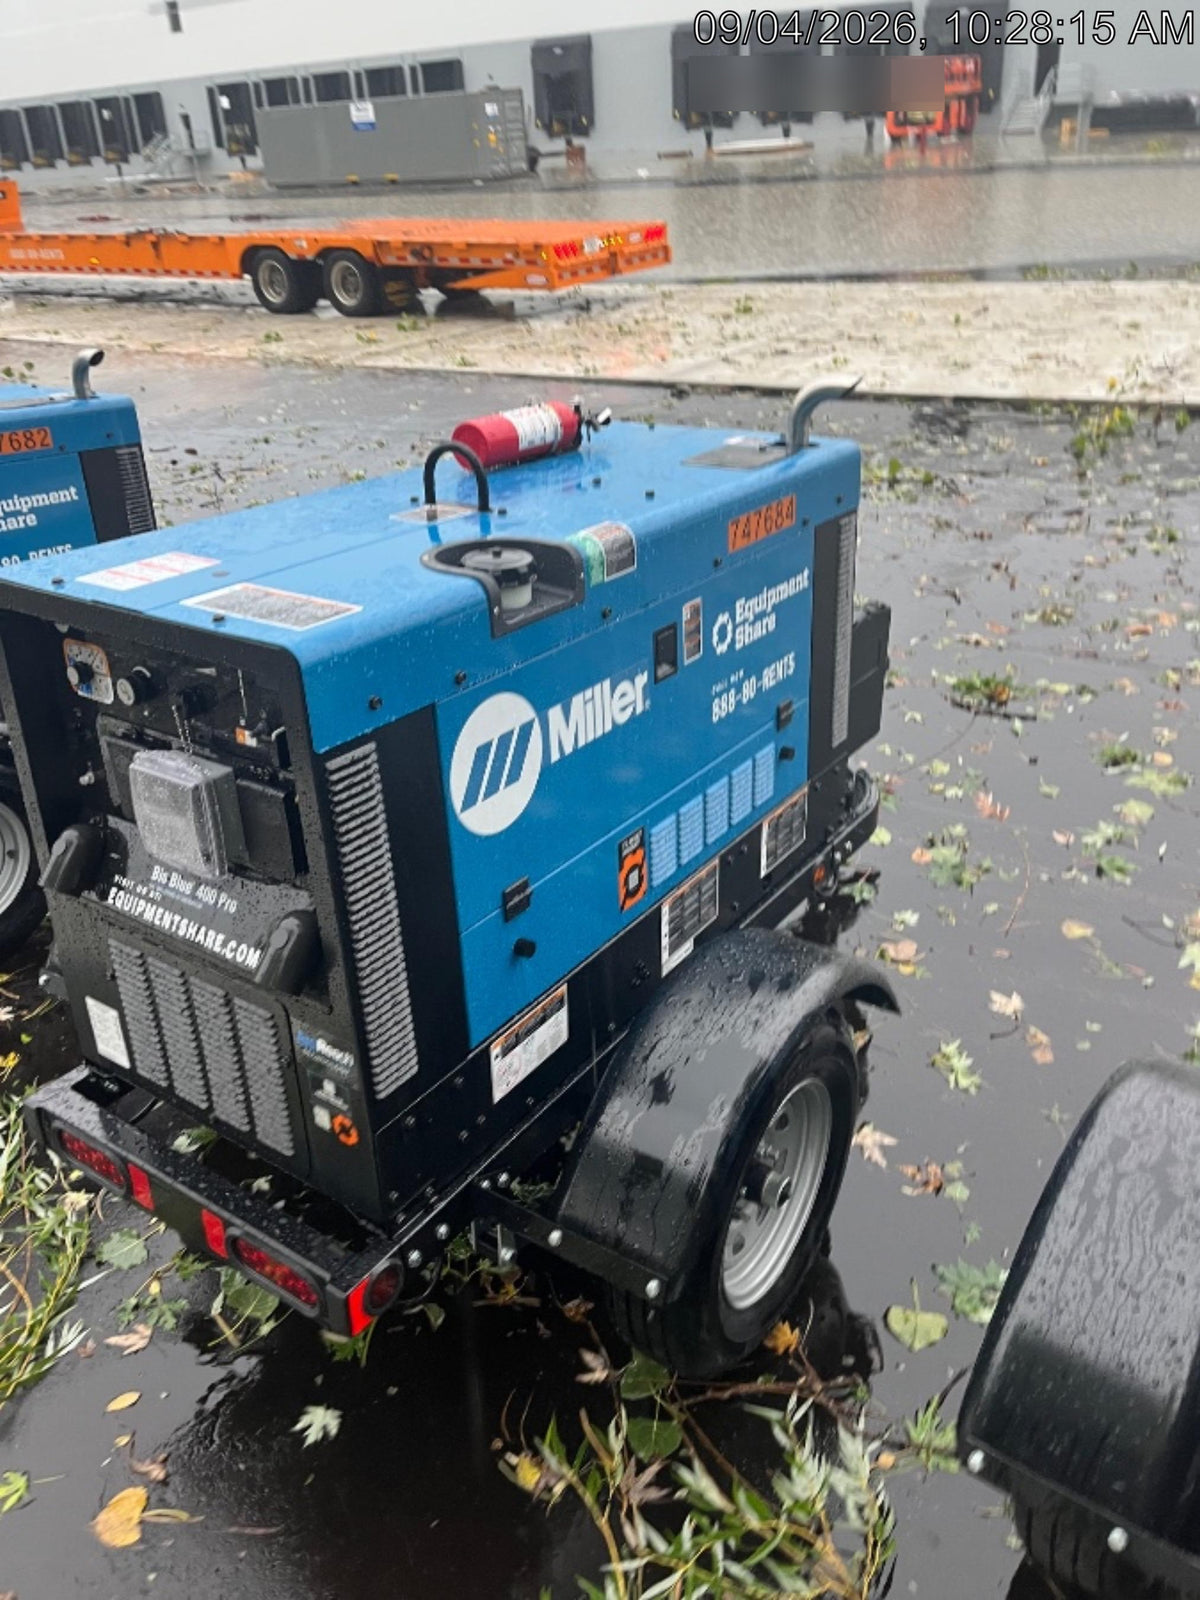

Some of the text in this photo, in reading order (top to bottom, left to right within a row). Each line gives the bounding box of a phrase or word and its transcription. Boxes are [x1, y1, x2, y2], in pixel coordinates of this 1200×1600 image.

[729, 496, 795, 550] 747684
[735, 566, 810, 625] Equipment
[735, 612, 777, 651] Share
[547, 669, 649, 765] Miller
[712, 651, 796, 724] 888-80-RENTS
[107, 886, 262, 970] EQUIPMENTSHARE.COM
